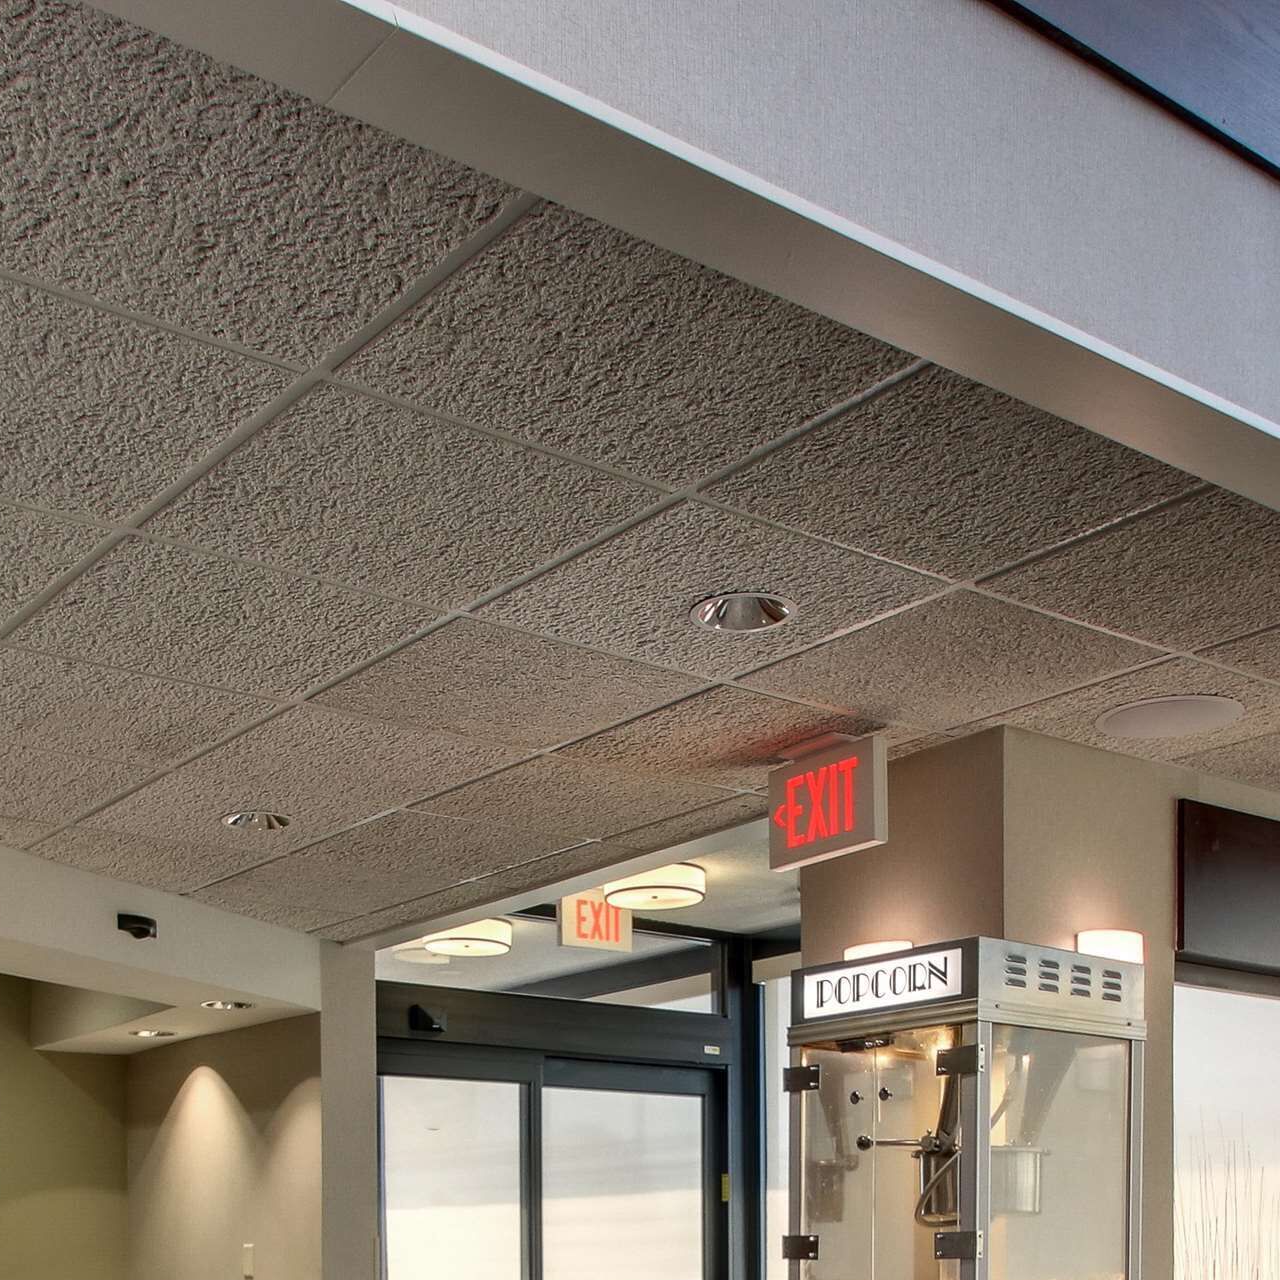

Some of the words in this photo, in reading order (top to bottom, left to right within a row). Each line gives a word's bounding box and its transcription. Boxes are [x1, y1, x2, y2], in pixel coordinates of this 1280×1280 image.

[786, 757, 858, 848] EXIT
[576, 899, 622, 943] EXIT
[816, 956, 948, 1008] POPCORN
